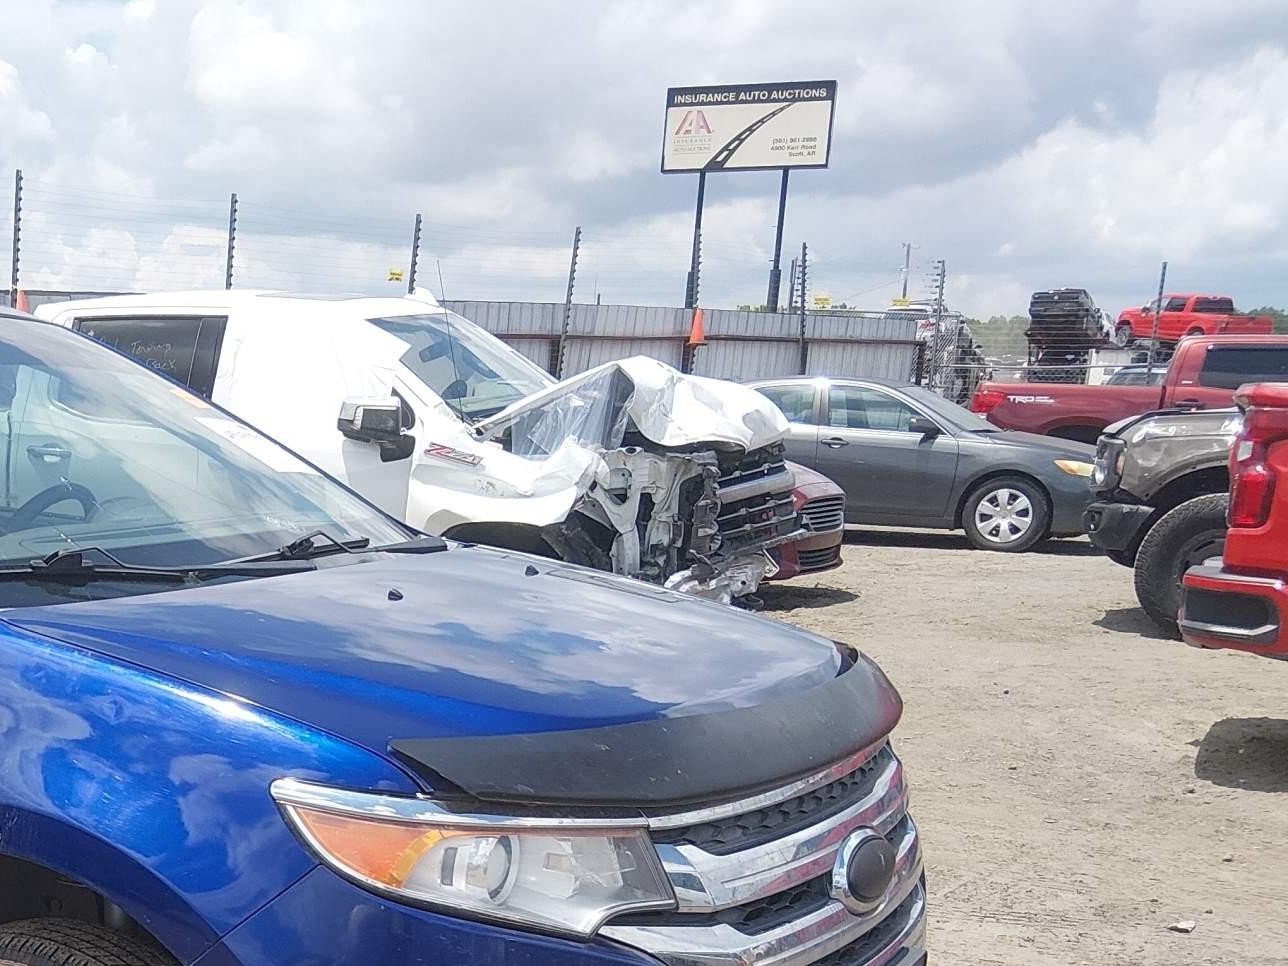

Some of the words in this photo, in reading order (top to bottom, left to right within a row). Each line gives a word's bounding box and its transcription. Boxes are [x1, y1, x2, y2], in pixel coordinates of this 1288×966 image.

[674, 93, 736, 104] INSURANCE
[739, 91, 768, 101] AUTO
[770, 88, 827, 99] AUCTIONS
[1007, 395, 1034, 404] TRD
